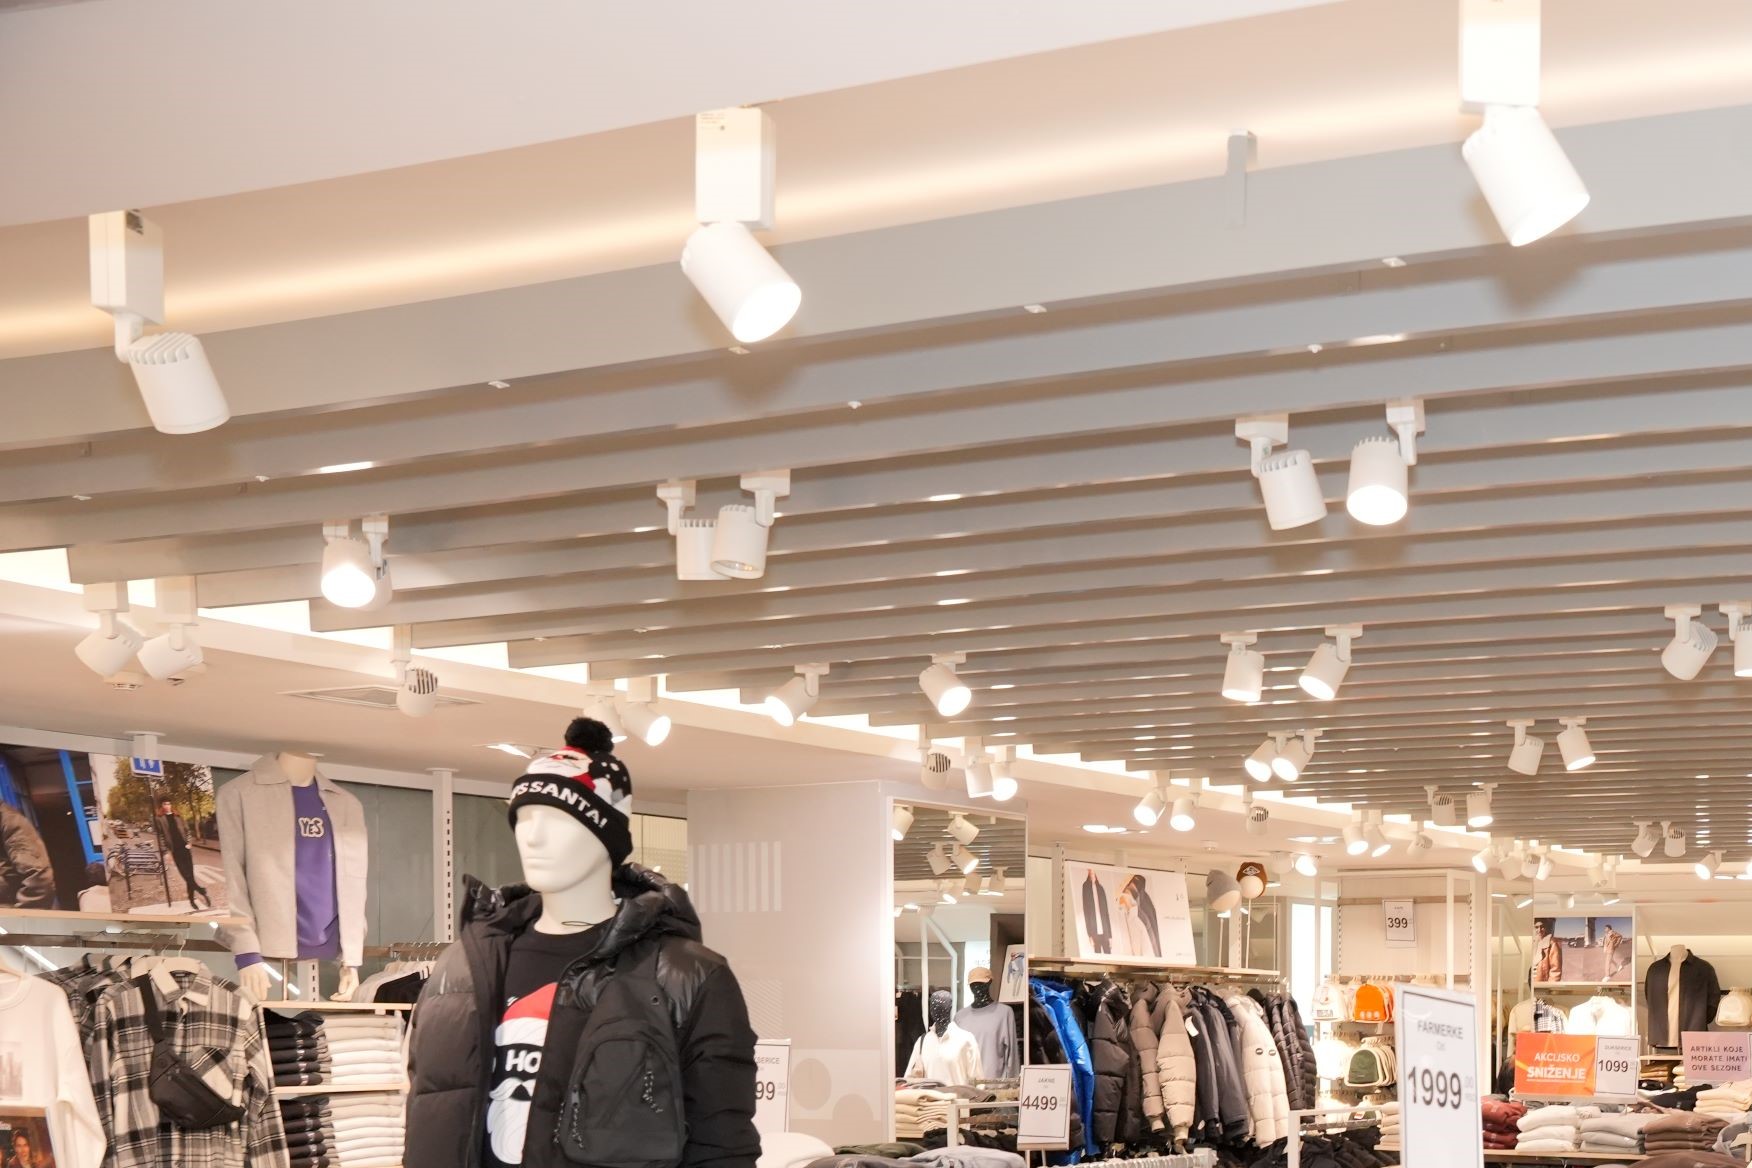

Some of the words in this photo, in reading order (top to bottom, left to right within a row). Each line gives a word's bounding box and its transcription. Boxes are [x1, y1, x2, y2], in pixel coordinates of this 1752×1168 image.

[299, 817, 325, 838] YES
[1387, 917, 1408, 928] 399
[1417, 1019, 1464, 1040] FARMERKE
[1534, 1053, 1580, 1062] AKCIJSKO
[1527, 1064, 1586, 1079] SNIŽENJE
[1598, 1059, 1629, 1072] 1099
[1711, 1064, 1742, 1072] SEZONE
[1408, 1065, 1462, 1110] 1999
[1022, 1095, 1058, 1111] 4499
